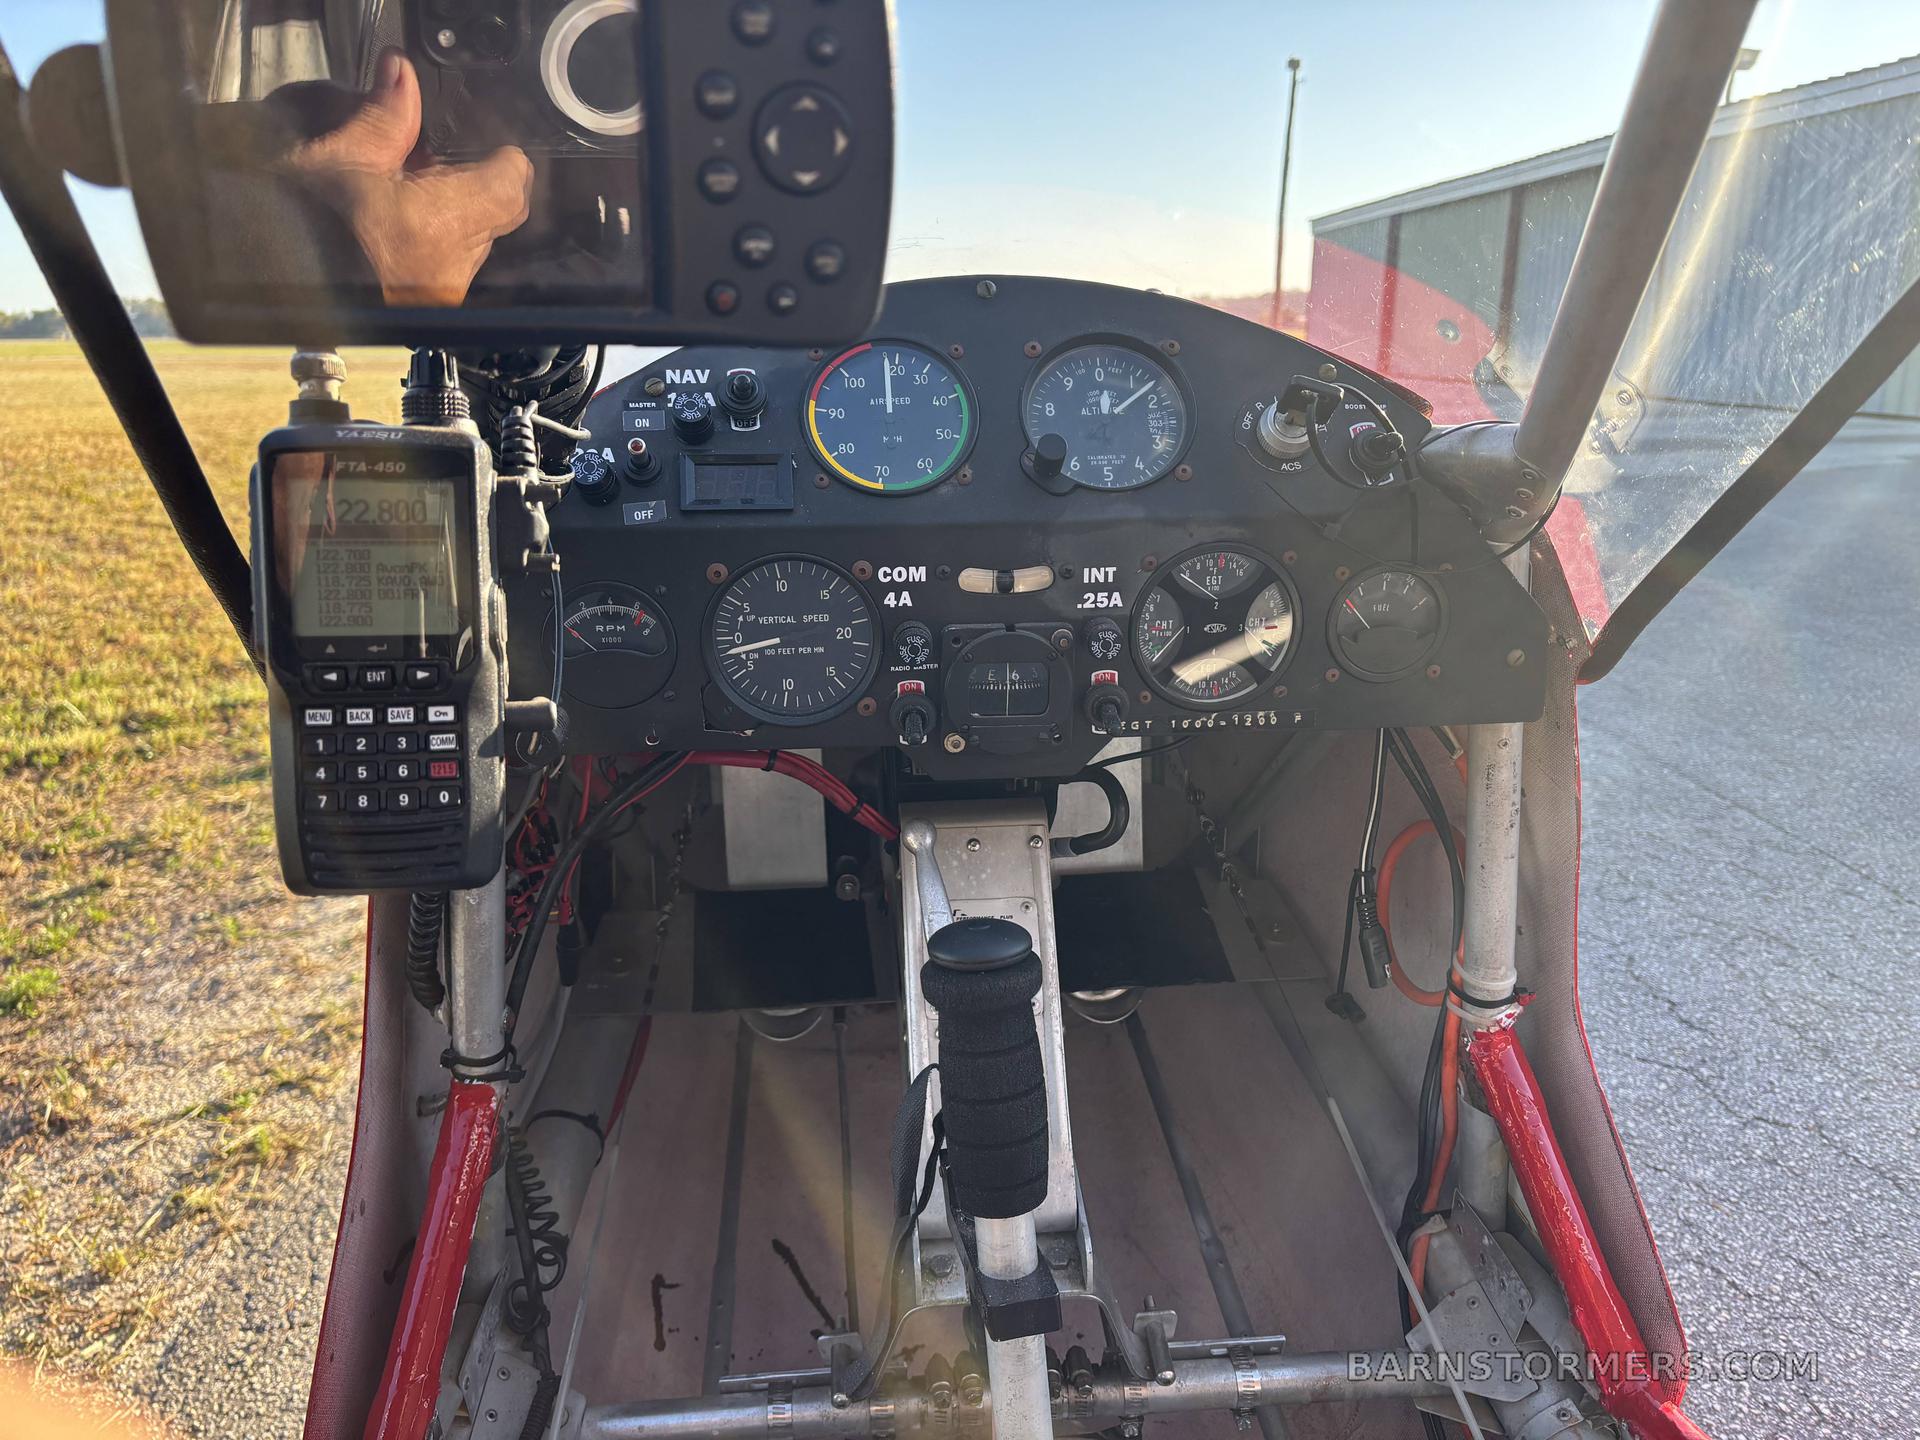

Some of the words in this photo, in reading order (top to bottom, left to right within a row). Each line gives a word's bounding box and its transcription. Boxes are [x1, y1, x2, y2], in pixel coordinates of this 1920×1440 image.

[666, 369, 710, 384] NAV
[890, 366, 905, 376] 20
[1095, 368, 1104, 382] 0
[844, 378, 865, 388] 100
[913, 374, 928, 384] 30
[1064, 377, 1073, 390] 9
[1130, 375, 1134, 388] 1
[870, 397, 910, 405] AIRPEED
[932, 396, 947, 406] 40
[1148, 395, 1157, 408] 2
[1256, 401, 1264, 411] R
[828, 409, 845, 419] 90
[1045, 403, 1055, 416] 8
[635, 418, 649, 428] ON
[737, 419, 755, 428] OFF
[1242, 411, 1253, 430] OFF
[334, 431, 403, 440] YAESU
[936, 429, 951, 439] 50
[1152, 435, 1162, 449] 3
[838, 443, 855, 454] 80
[335, 461, 406, 473] FTA-450
[917, 458, 932, 468] 60
[1071, 456, 1080, 470] 6
[1135, 456, 1144, 470] 4
[1281, 462, 1302, 471] ACS
[874, 466, 889, 476] 70
[1104, 467, 1113, 481] 5
[634, 510, 654, 520] OFF
[878, 566, 926, 582] COM
[1083, 567, 1117, 584] INT
[776, 580, 787, 592] 10
[1206, 576, 1222, 585] EGT
[820, 590, 830, 600] 15
[883, 591, 913, 608] 4A
[1076, 592, 1123, 609] .25A
[580, 602, 586, 610] 2
[744, 603, 750, 612] 5
[758, 616, 796, 624] VERTICAL
[803, 614, 829, 623] SPEED
[1156, 620, 1173, 629] CHT
[1249, 617, 1266, 627] CHT
[734, 633, 742, 644] 0
[836, 628, 852, 639] 20
[1098, 631, 1118, 641] FUSE
[906, 636, 926, 646] FUSE
[747, 661, 754, 670] 5
[826, 666, 836, 676] 15
[367, 672, 386, 682] ENT
[988, 669, 996, 680] E
[1012, 670, 1020, 680] 6
[782, 678, 794, 690] 10
[308, 711, 331, 723] MENU
[349, 710, 371, 722] BACK
[390, 708, 412, 721] SAVE
[1120, 720, 1152, 730] EGT
[316, 739, 324, 751] 1
[356, 738, 366, 750] 2
[398, 737, 406, 748] 3
[430, 735, 455, 748] COMM
[316, 767, 326, 780] 4
[358, 767, 367, 778] 5
[399, 765, 408, 776] 6
[318, 796, 327, 808] 7
[358, 795, 368, 807] 8
[400, 794, 409, 806] 9
[440, 791, 449, 803] 0
